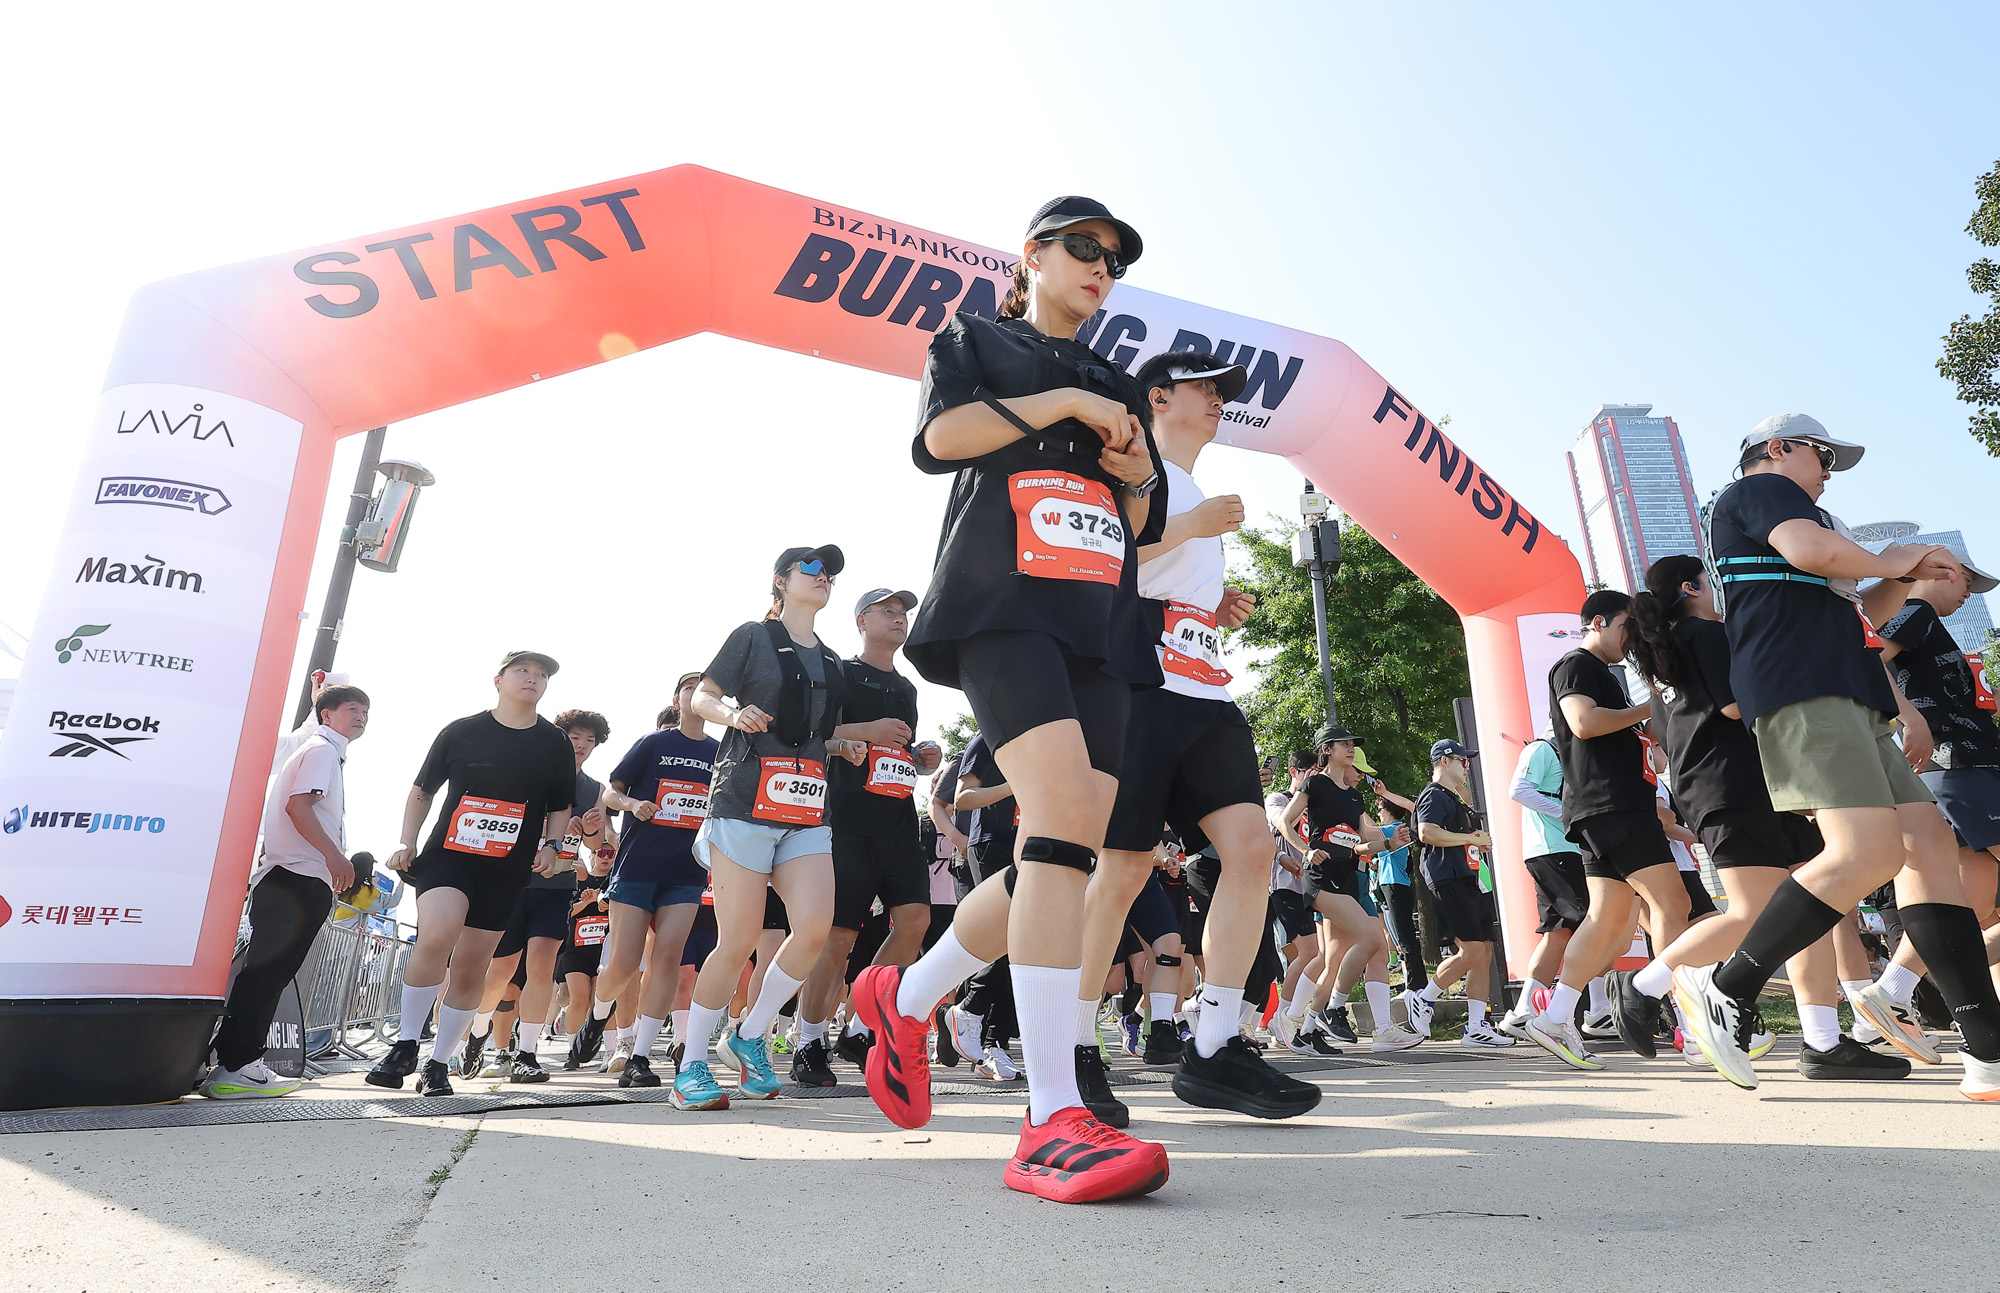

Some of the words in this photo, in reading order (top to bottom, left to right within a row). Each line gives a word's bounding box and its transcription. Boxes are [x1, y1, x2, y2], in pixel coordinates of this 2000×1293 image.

[293, 188, 646, 318] START
[1218, 408, 1272, 429] estival
[1372, 385, 1539, 554] FINISH
[1016, 477, 1065, 489] BURNING
[1066, 480, 1085, 491] RUN
[103, 482, 211, 505] FAVONEX
[1042, 512, 1061, 525] W
[1069, 511, 1122, 542] 3729
[75, 554, 204, 593] Maxim
[1181, 628, 1195, 642] M
[1169, 639, 1188, 652] B-60
[82, 648, 194, 672] NEWTREE
[49, 711, 161, 733] Reebok
[659, 755, 715, 772] XPODIU
[881, 763, 888, 771] M
[892, 763, 916, 778] 1964
[774, 781, 787, 791] W
[789, 781, 825, 797] 3501
[666, 798, 676, 806] W
[464, 818, 475, 827] W
[477, 819, 519, 834] 3859
[460, 836, 479, 845] A-145
[563, 836, 579, 847] 32
[22, 905, 143, 925] 롯데웰푸드
[282, 1022, 299, 1049] LINE
